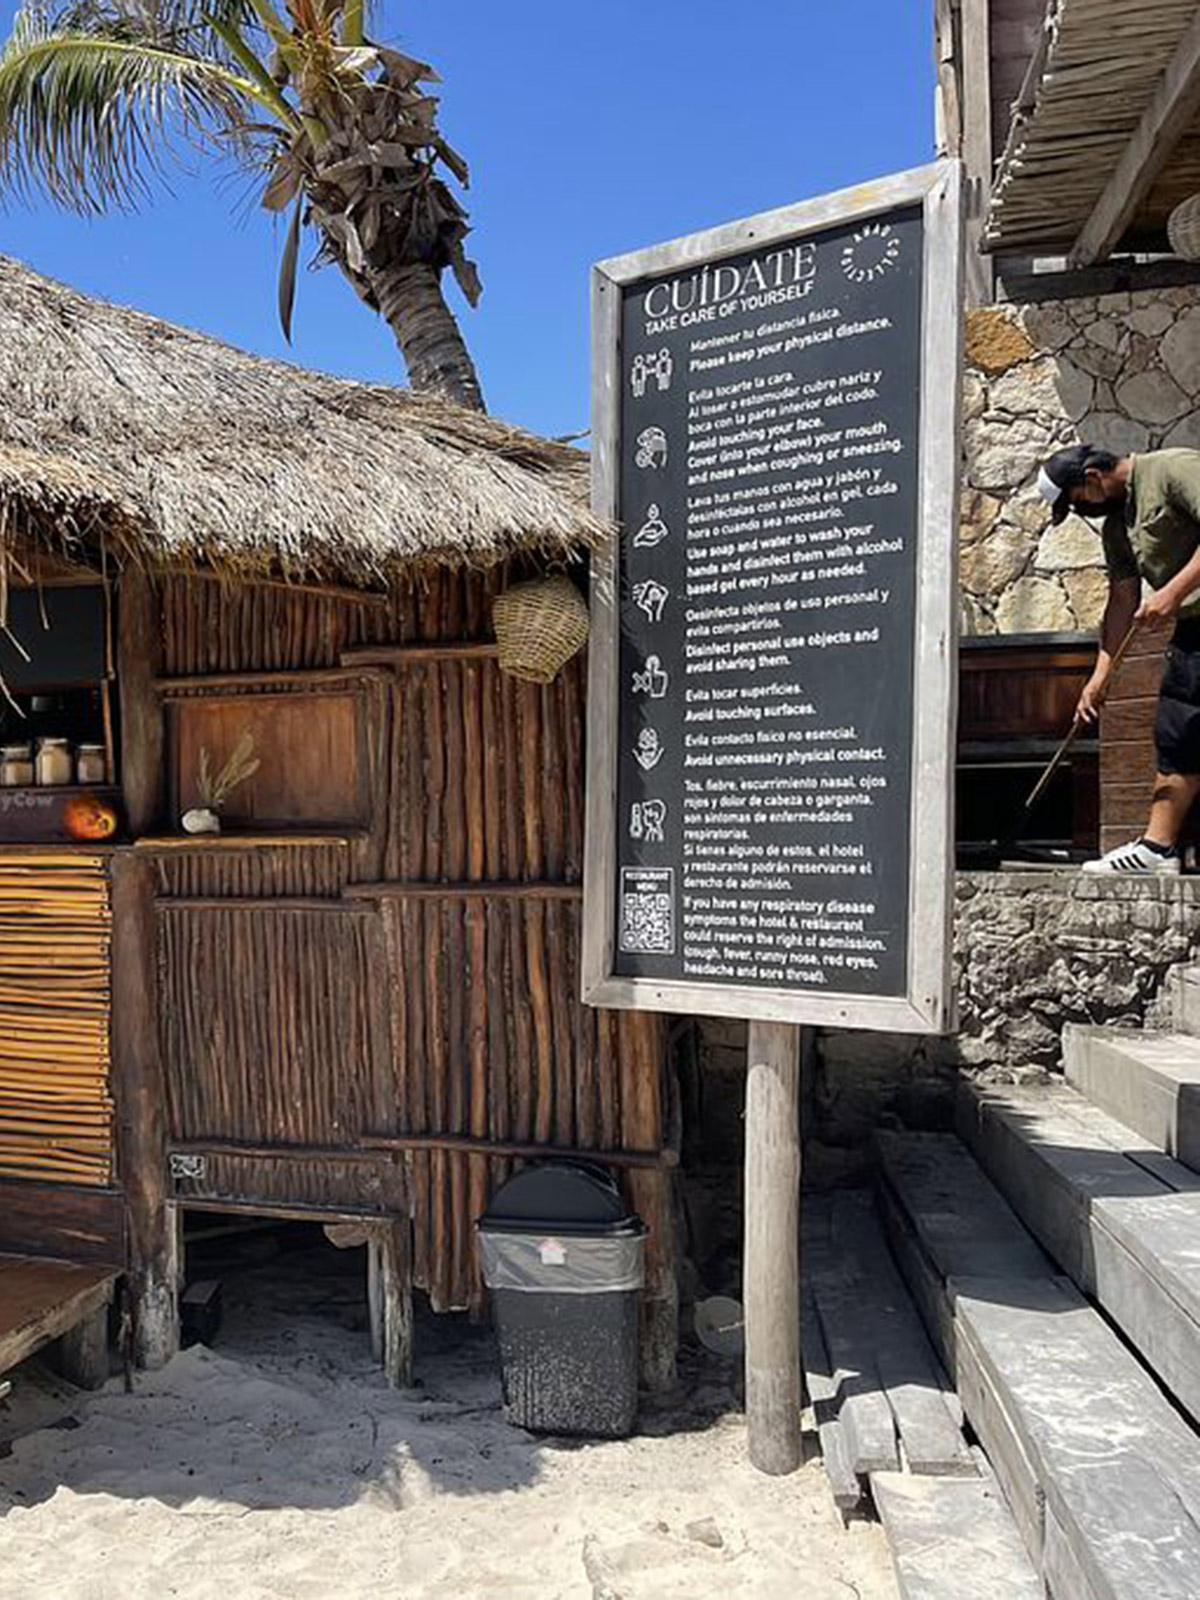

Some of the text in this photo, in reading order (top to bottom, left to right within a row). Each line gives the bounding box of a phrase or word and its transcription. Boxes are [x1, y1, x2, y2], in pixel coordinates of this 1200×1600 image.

[645, 279, 813, 335] TAKE CARE OF YOURSELF
[689, 317, 892, 371] Please keep your physical distance.
[690, 316, 806, 352] Mantener distancia
[688, 372, 794, 403] Evita tocarte la cara.
[688, 370, 882, 418] Al o cubre nariz y
[688, 387, 878, 435] boca con la parte interior del codo.
[687, 417, 824, 452] Avoid touching your face.
[687, 421, 887, 468] Cover your your mouth
[687, 448, 840, 485] and nose when coughing or
[687, 468, 881, 508] Lava tus manos con agua y y
[756, 480, 897, 512] con alcohol en cada
[686, 516, 782, 539] hora o cuando sea
[686, 524, 873, 560] Use soap and water to wash your
[686, 537, 903, 577] hands and them with alcohol
[686, 561, 866, 595] based gel every hour as needed.
[783, 598, 797, 610] de
[800, 597, 822, 608] uso
[824, 588, 878, 608] personal
[880, 590, 889, 603] y
[686, 624, 710, 637] evita
[685, 627, 879, 657] Disinfect personal use objects and
[685, 654, 790, 673] avoid sharing them.
[685, 688, 738, 702] Evita tocar
[684, 702, 816, 721] Avoid touching surfaces.
[684, 726, 857, 747] Evita no esencial.
[684, 747, 886, 766] Avoid unnecessary physical contact.
[859, 774, 886, 790] ojos
[711, 794, 813, 809] y de cabeza o
[683, 810, 853, 823] son de enfermedades
[683, 843, 863, 858] Si alguno de el hotel
[682, 860, 872, 874] y restaurante reservarse el
[683, 876, 738, 888] derecho de
[691, 896, 874, 915] you have any respiratory disease
[683, 914, 863, 931] symptoms the hotel & restaurant
[683, 929, 886, 950] could reserve the right of admission.
[754, 950, 843, 966] runny red
[683, 961, 783, 979] headache and sore
